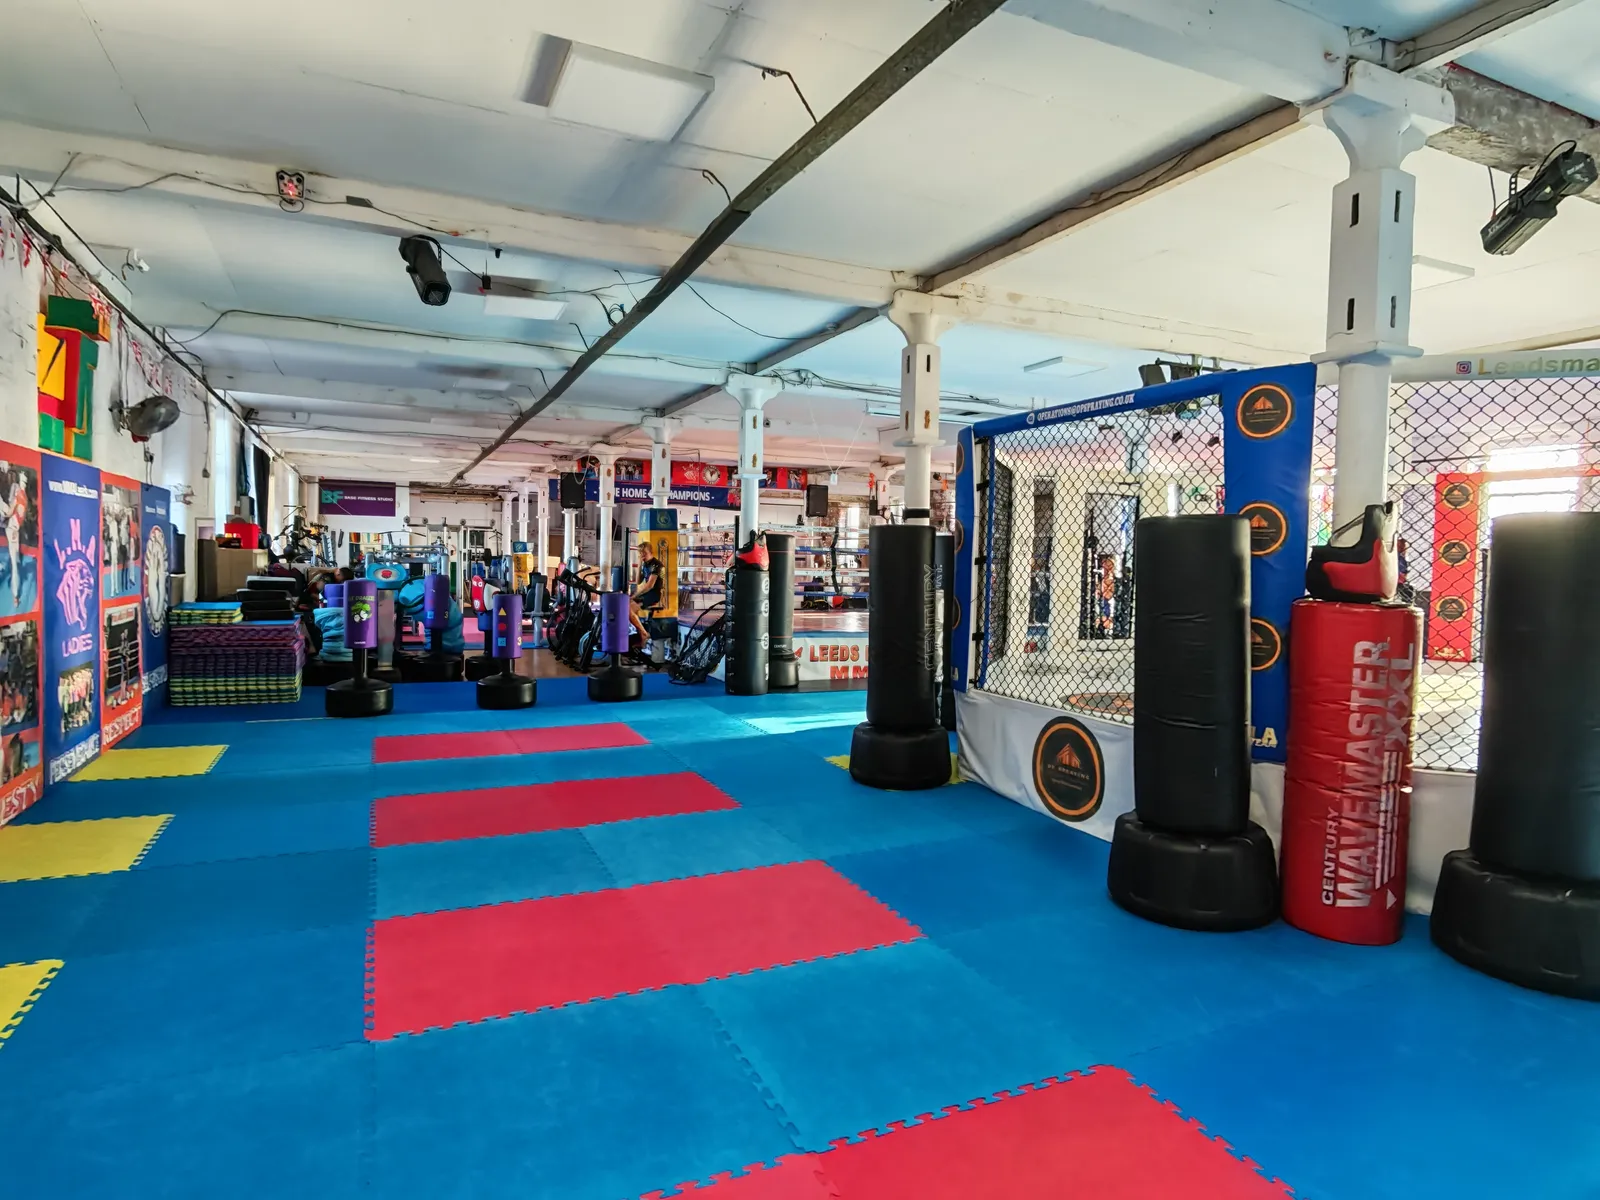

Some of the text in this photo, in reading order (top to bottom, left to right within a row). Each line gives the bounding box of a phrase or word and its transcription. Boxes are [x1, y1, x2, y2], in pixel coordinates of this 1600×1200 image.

[622, 487, 647, 499] HOME
[669, 489, 711, 501] HAMPIONS
[809, 644, 860, 662] LEEDS
[1334, 640, 1390, 908] WAVEMASTER
[1321, 806, 1339, 907] CENTURY
